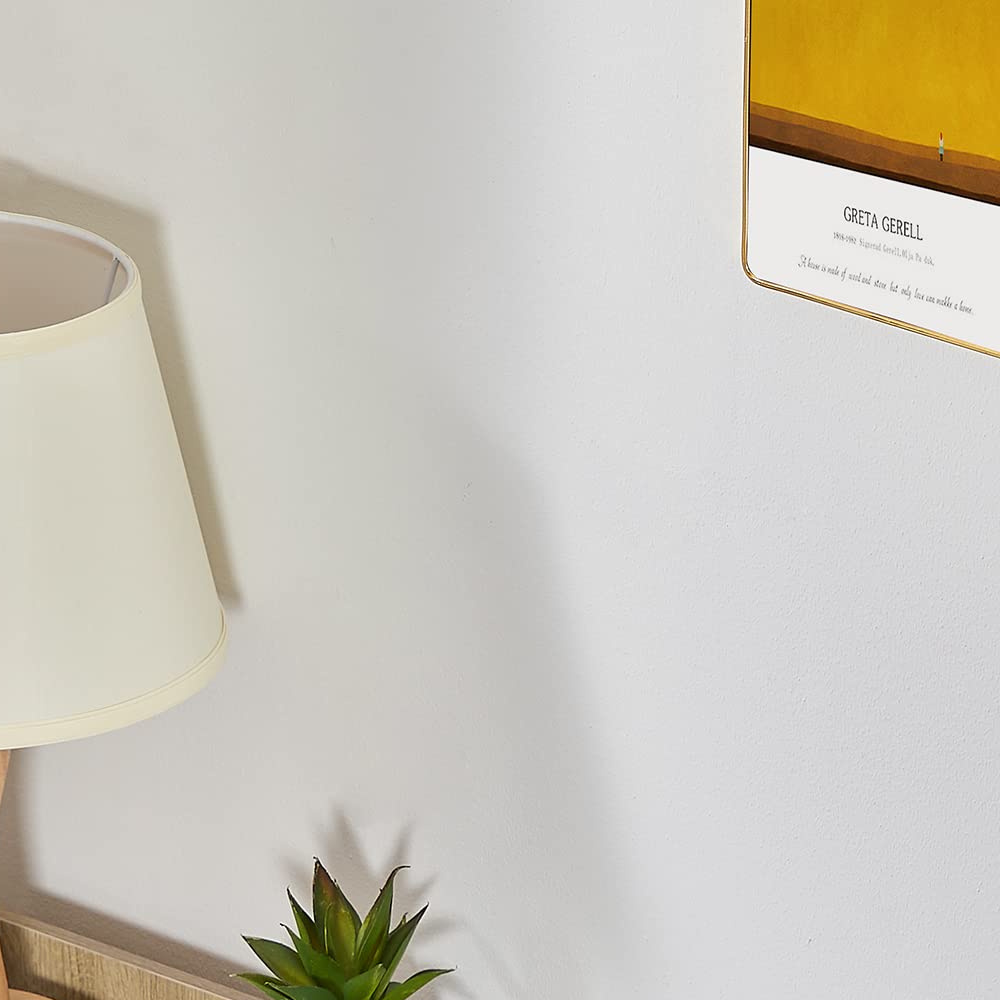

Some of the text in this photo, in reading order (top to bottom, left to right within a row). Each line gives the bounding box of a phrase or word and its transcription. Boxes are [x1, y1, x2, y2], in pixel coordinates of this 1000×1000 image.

[843, 206, 923, 241] GRETA GERELL
[841, 266, 848, 282] of
